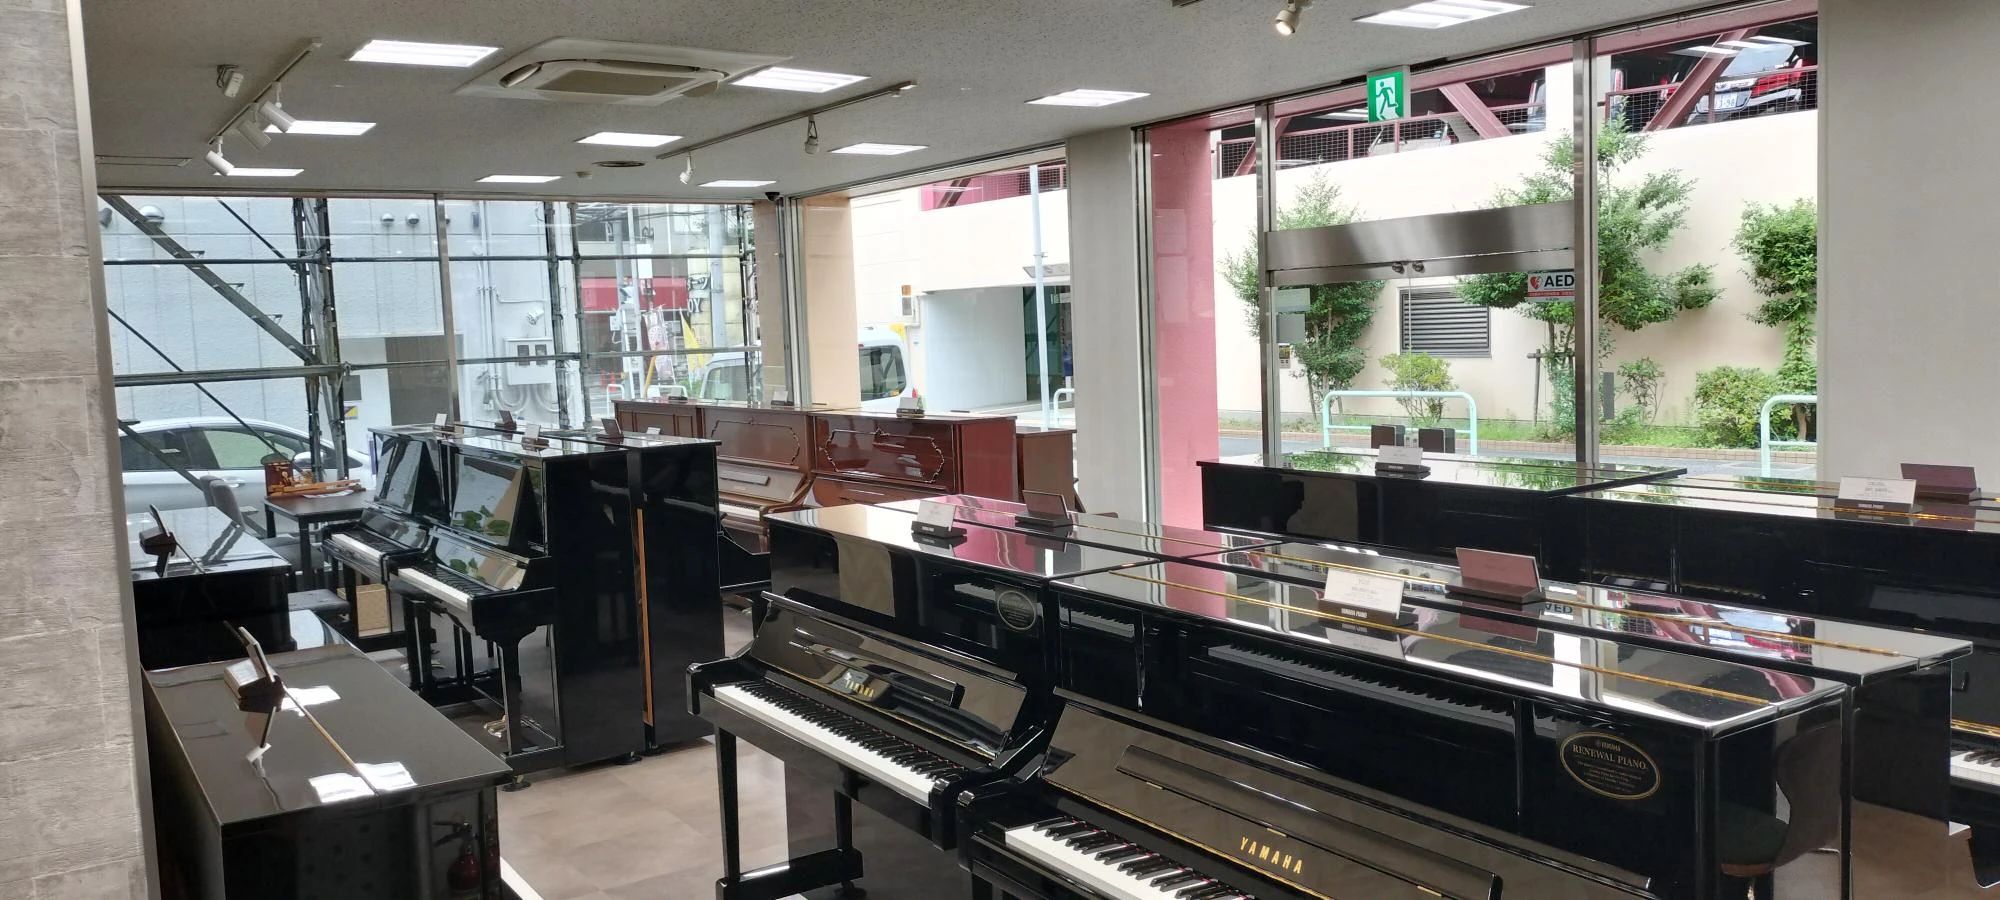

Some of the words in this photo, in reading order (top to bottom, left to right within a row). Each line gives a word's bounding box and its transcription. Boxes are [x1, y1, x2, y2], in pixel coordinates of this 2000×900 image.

[1544, 274, 1575, 287] AED
[1572, 744, 1615, 762] RENEWAL
[1617, 755, 1647, 770] PIANO
[1240, 836, 1303, 875] YAMAHA
